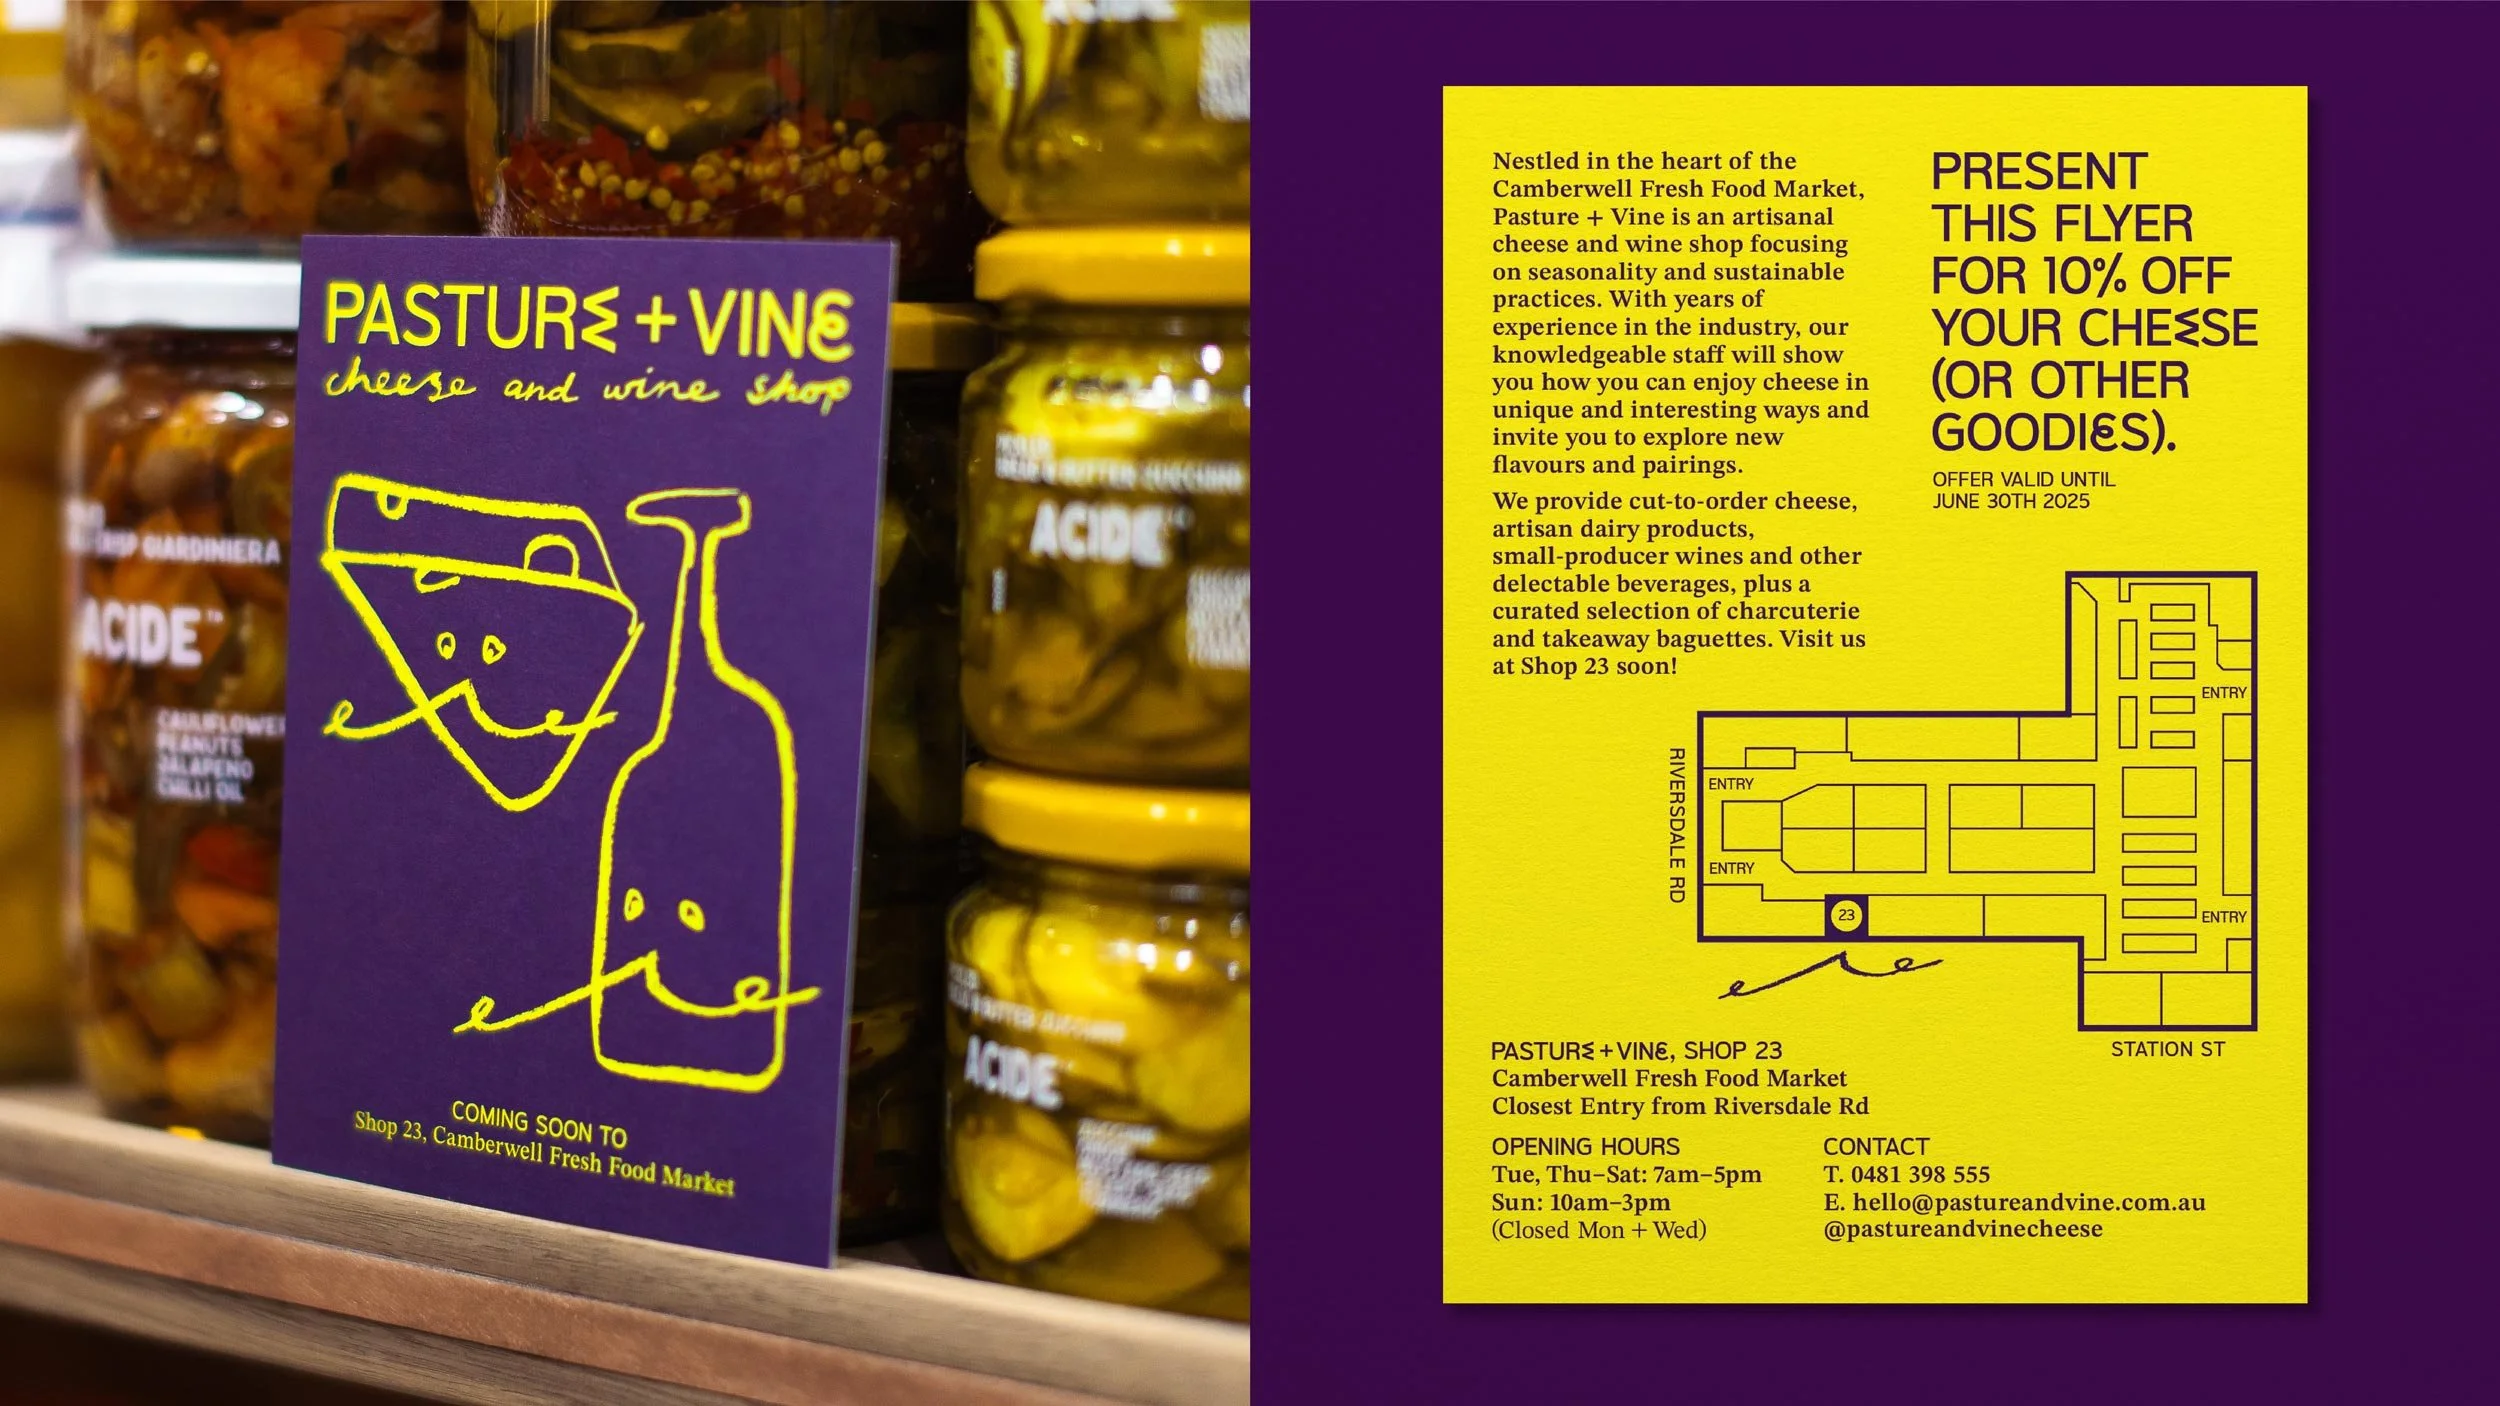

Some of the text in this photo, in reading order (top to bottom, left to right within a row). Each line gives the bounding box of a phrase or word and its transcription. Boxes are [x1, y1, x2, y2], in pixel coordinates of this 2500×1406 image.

[1493, 150, 1797, 170] Nestled in the heart of the
[1933, 151, 2149, 191] PRESENT
[1493, 178, 1865, 201] Camberwell Fresh Food Market,
[1493, 207, 1579, 226] Pasture
[1610, 207, 1665, 226] Vine
[1672, 207, 1691, 226] is
[1696, 211, 1725, 226] an
[1732, 206, 1833, 226] artisanal
[1931, 203, 2193, 243] THIS FLYER
[1492, 233, 1849, 259] cheese and wine shop focusing
[1492, 261, 1845, 286] on seasonality and sustainable
[1933, 252, 2233, 299] FOR 10% OFF
[1493, 288, 1766, 313] practices. With years of
[324, 280, 619, 354] PASTURE
[689, 288, 854, 363] VINE
[1492, 316, 1849, 341] experience in the industry, our
[1931, 307, 2259, 348] YOUR CHEESE
[1492, 344, 1845, 369] knowledgeable staff will show
[324, 355, 852, 416] cheese and wine shop
[1491, 371, 1870, 397] you how you can enjoy cheese in
[1932, 356, 2189, 403] (OR OTHER
[1932, 408, 2177, 456] GOODIES).
[1492, 454, 1743, 480] flavours and pairings.
[1932, 471, 2117, 487] OFFER VALID UNTIL
[1492, 490, 1857, 515] We provide cut-to-order cheese,
[1932, 492, 2091, 509] JUNE 30TH 2025
[1492, 545, 1863, 570] small-producer wines and other
[1492, 628, 1866, 653] and takeaway baguettes. Visit us
[1492, 655, 1677, 680] at Shop 23 soon!
[2202, 686, 2248, 699] ENTRY
[1708, 777, 1755, 790] ENTRY
[1669, 748, 1686, 904] RIVERSDALE RD
[1709, 861, 1755, 875] ENTRY
[1838, 908, 1855, 921] 23
[2201, 910, 2248, 924] ENTRY
[1491, 1041, 1595, 1061] PASTURE
[1616, 1041, 1676, 1064] VINE,
[1684, 1040, 1747, 1060] SHOP
[1755, 1040, 1783, 1060] 23
[2111, 1040, 2227, 1057] STATION ST
[1492, 1068, 1848, 1088] Camberwell Fresh Food Market
[1492, 1095, 1870, 1121] Closest Entry from Riversdale Rd
[452, 1100, 628, 1148] COMING SOON TO
[354, 1110, 735, 1197] Shop 23, Camberwell Fresh Food Market
[1492, 1137, 1681, 1156] OPENING HOURS
[1823, 1137, 1931, 1156] CONTACT
[1491, 1165, 1541, 1187] Tue,
[1823, 1165, 1991, 1184] T. 0481 398 555
[1492, 1192, 1543, 1212] Sun:
[1823, 1192, 2206, 1217] E. hello@pastureandvine.com.au
[1492, 1218, 1570, 1242] (Closed
[1578, 1221, 1625, 1239] Mon
[1652, 1218, 1707, 1242] Wed)
[1824, 1218, 2103, 1243] @pastureandvinecheese
